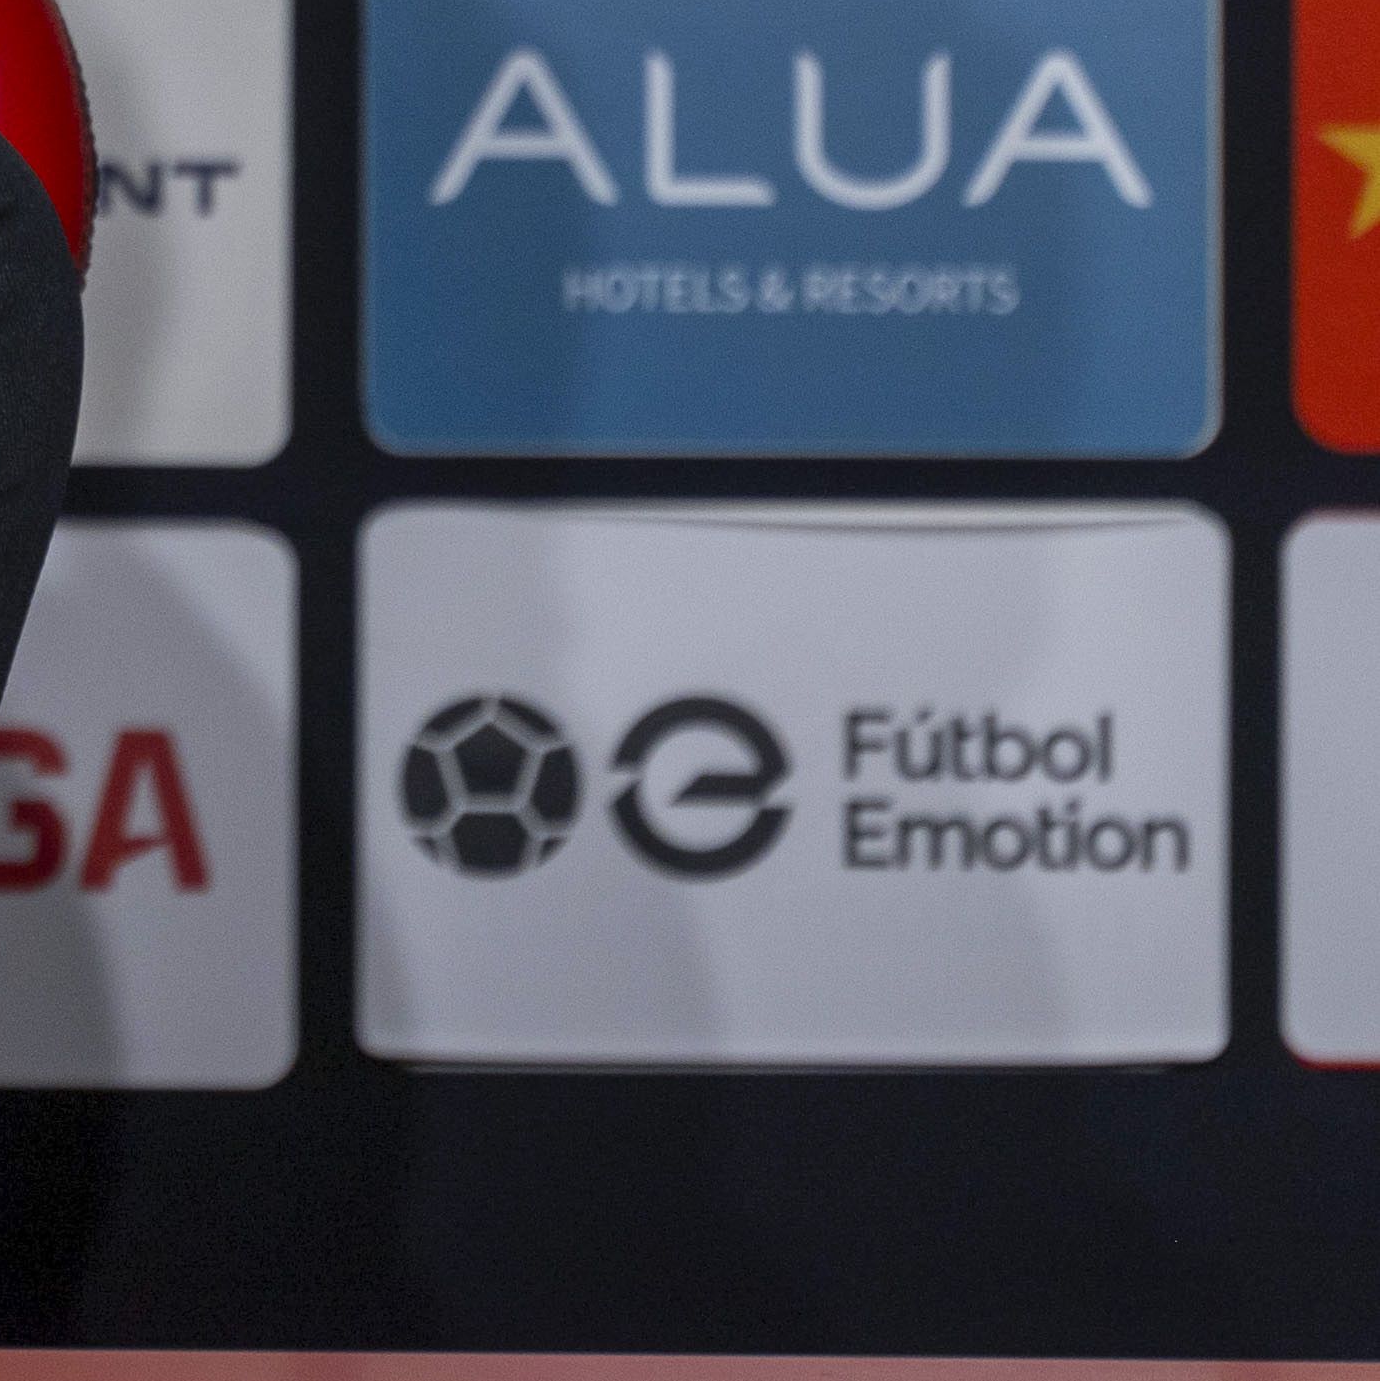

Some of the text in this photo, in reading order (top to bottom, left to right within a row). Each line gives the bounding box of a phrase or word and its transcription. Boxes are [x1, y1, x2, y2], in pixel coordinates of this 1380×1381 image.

[429, 47, 1154, 211] ALUA
[561, 266, 1023, 316] HOTELS & RESORTS
[842, 708, 1114, 783] Fútbol
